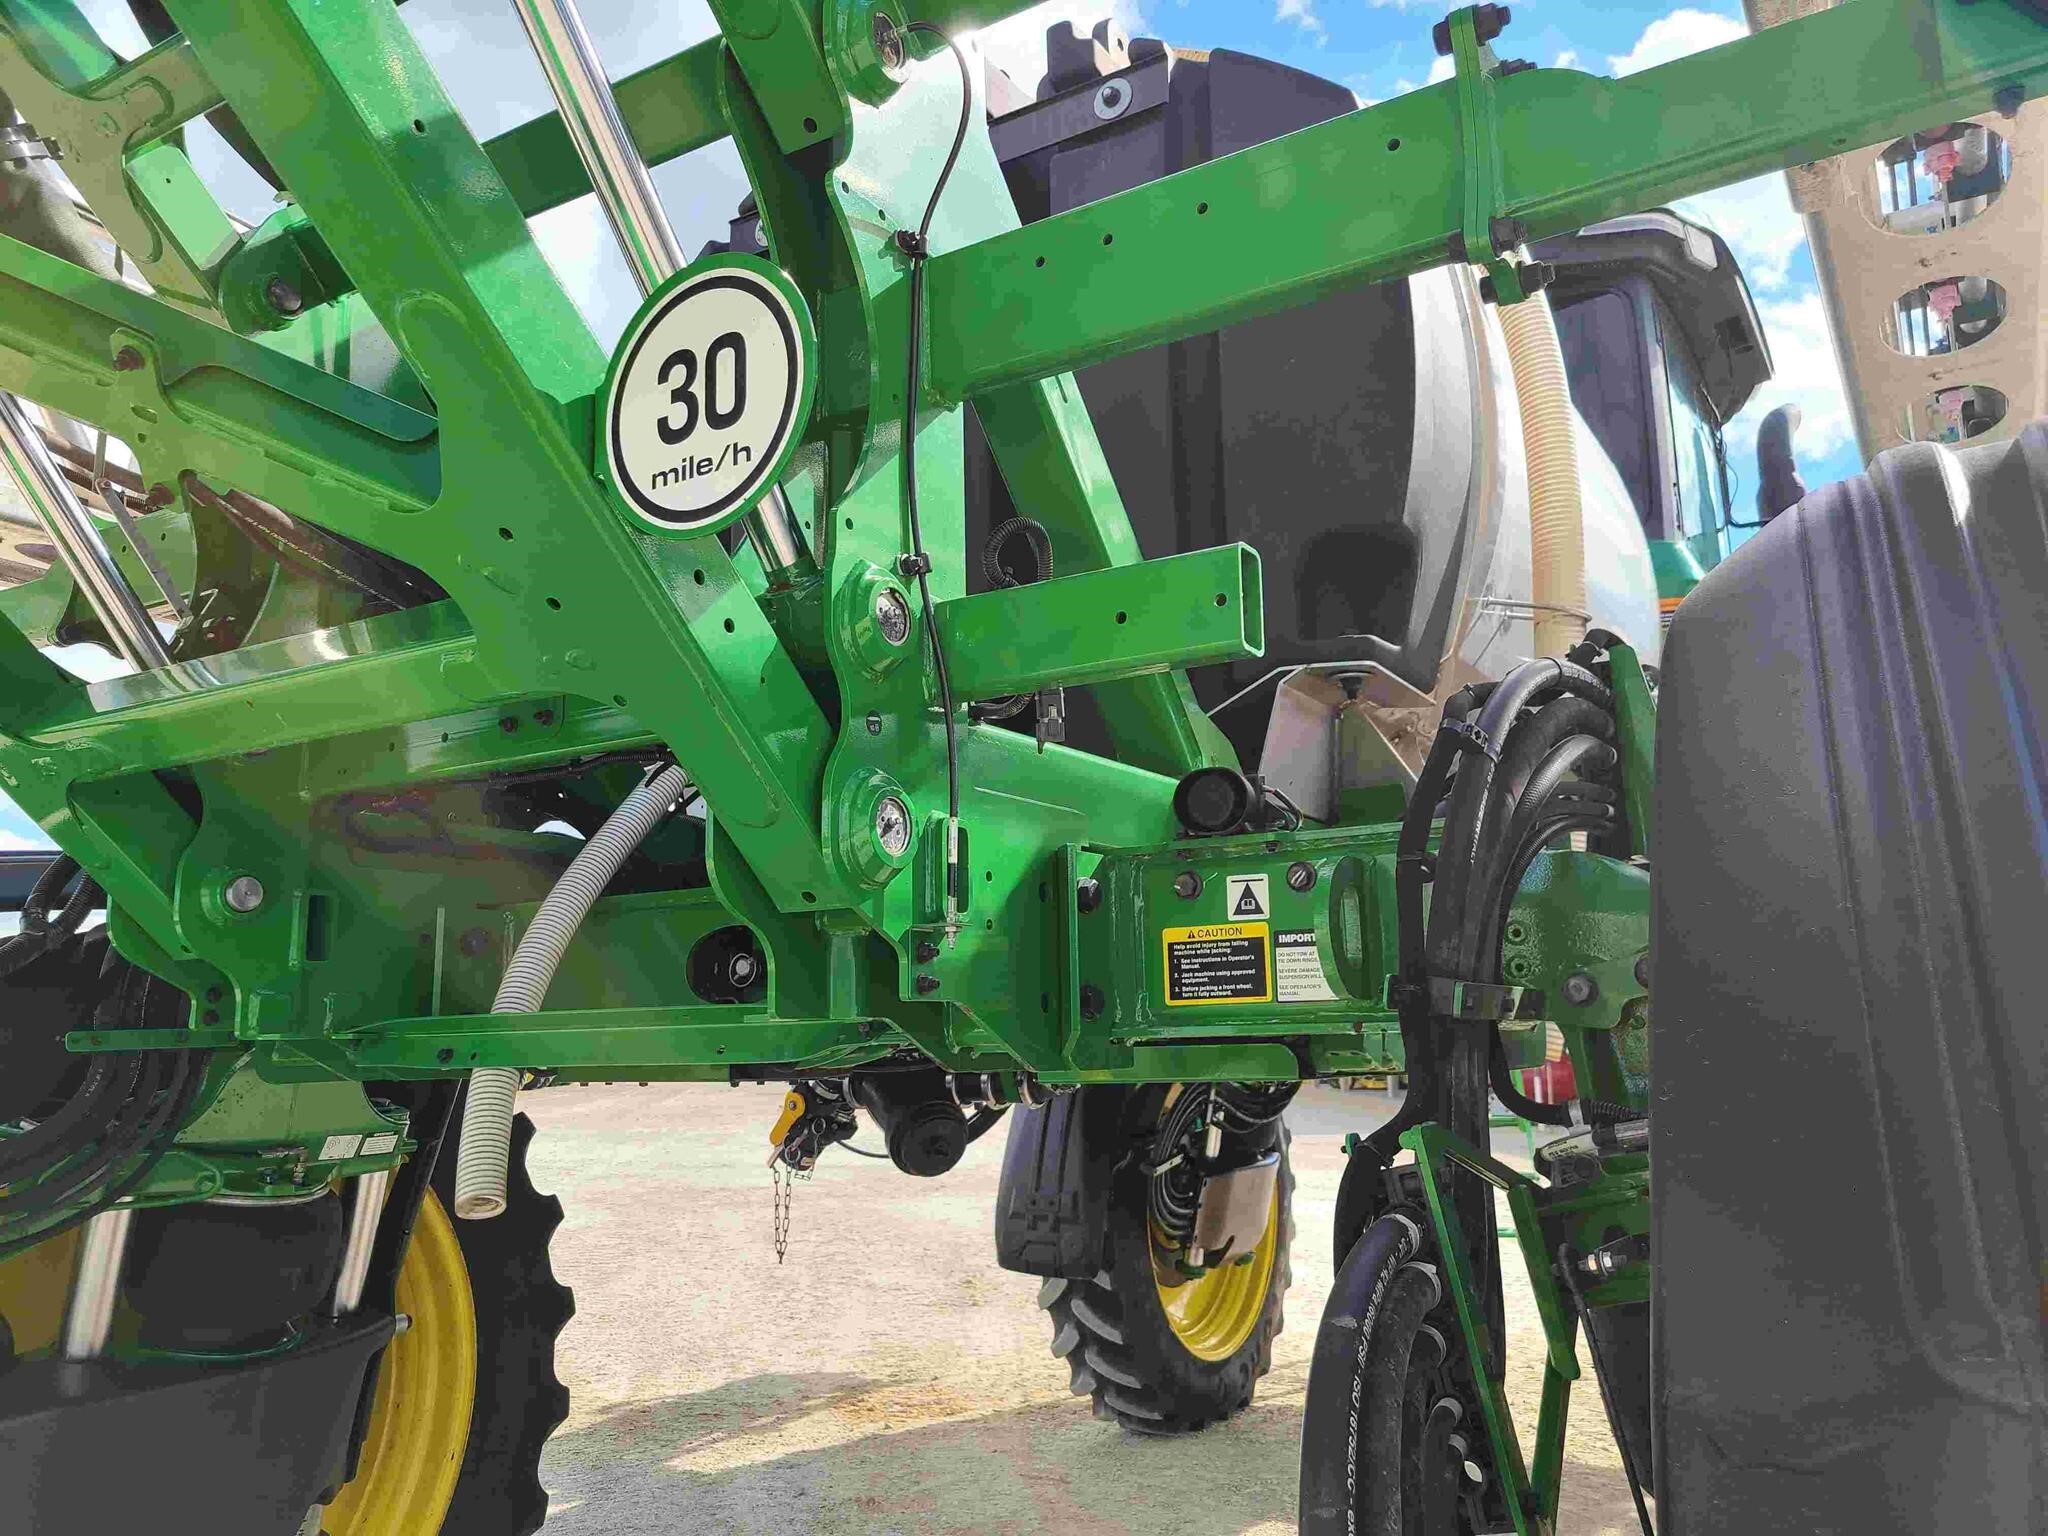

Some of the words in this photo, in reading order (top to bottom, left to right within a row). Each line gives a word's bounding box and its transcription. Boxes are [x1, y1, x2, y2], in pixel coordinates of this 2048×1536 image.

[657, 331, 746, 445] 30
[651, 442, 751, 490] mile/h
[1197, 928, 1243, 938] CAUTION
[1351, 1375, 1362, 1408] ISO
